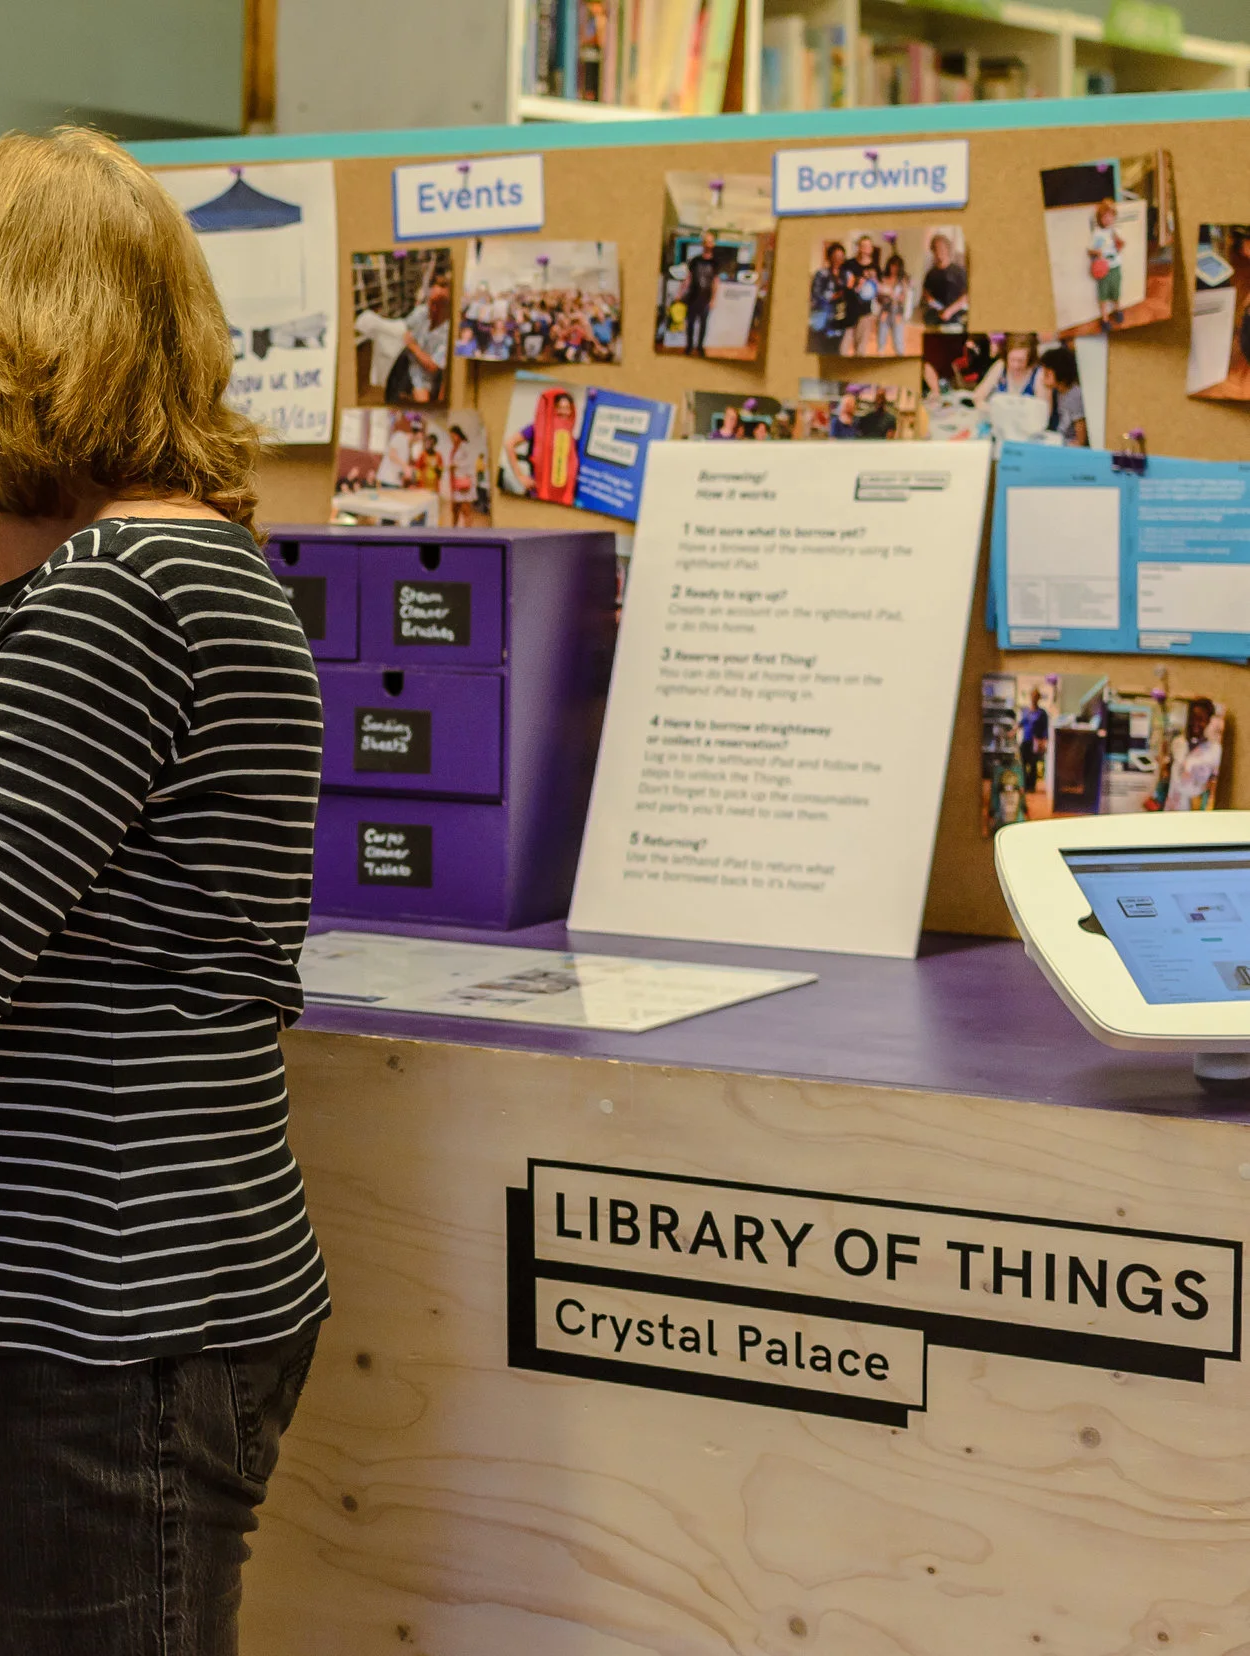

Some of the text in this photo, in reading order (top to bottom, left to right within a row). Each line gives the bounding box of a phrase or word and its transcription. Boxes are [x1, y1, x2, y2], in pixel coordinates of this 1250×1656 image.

[796, 161, 948, 195] Borrowing
[417, 178, 524, 213] Events
[361, 714, 412, 742] Sanding
[361, 735, 409, 753] Sheets
[554, 1191, 1210, 1321] LIBRARY OF THINGS
[555, 1299, 890, 1382] Crystal Palace
